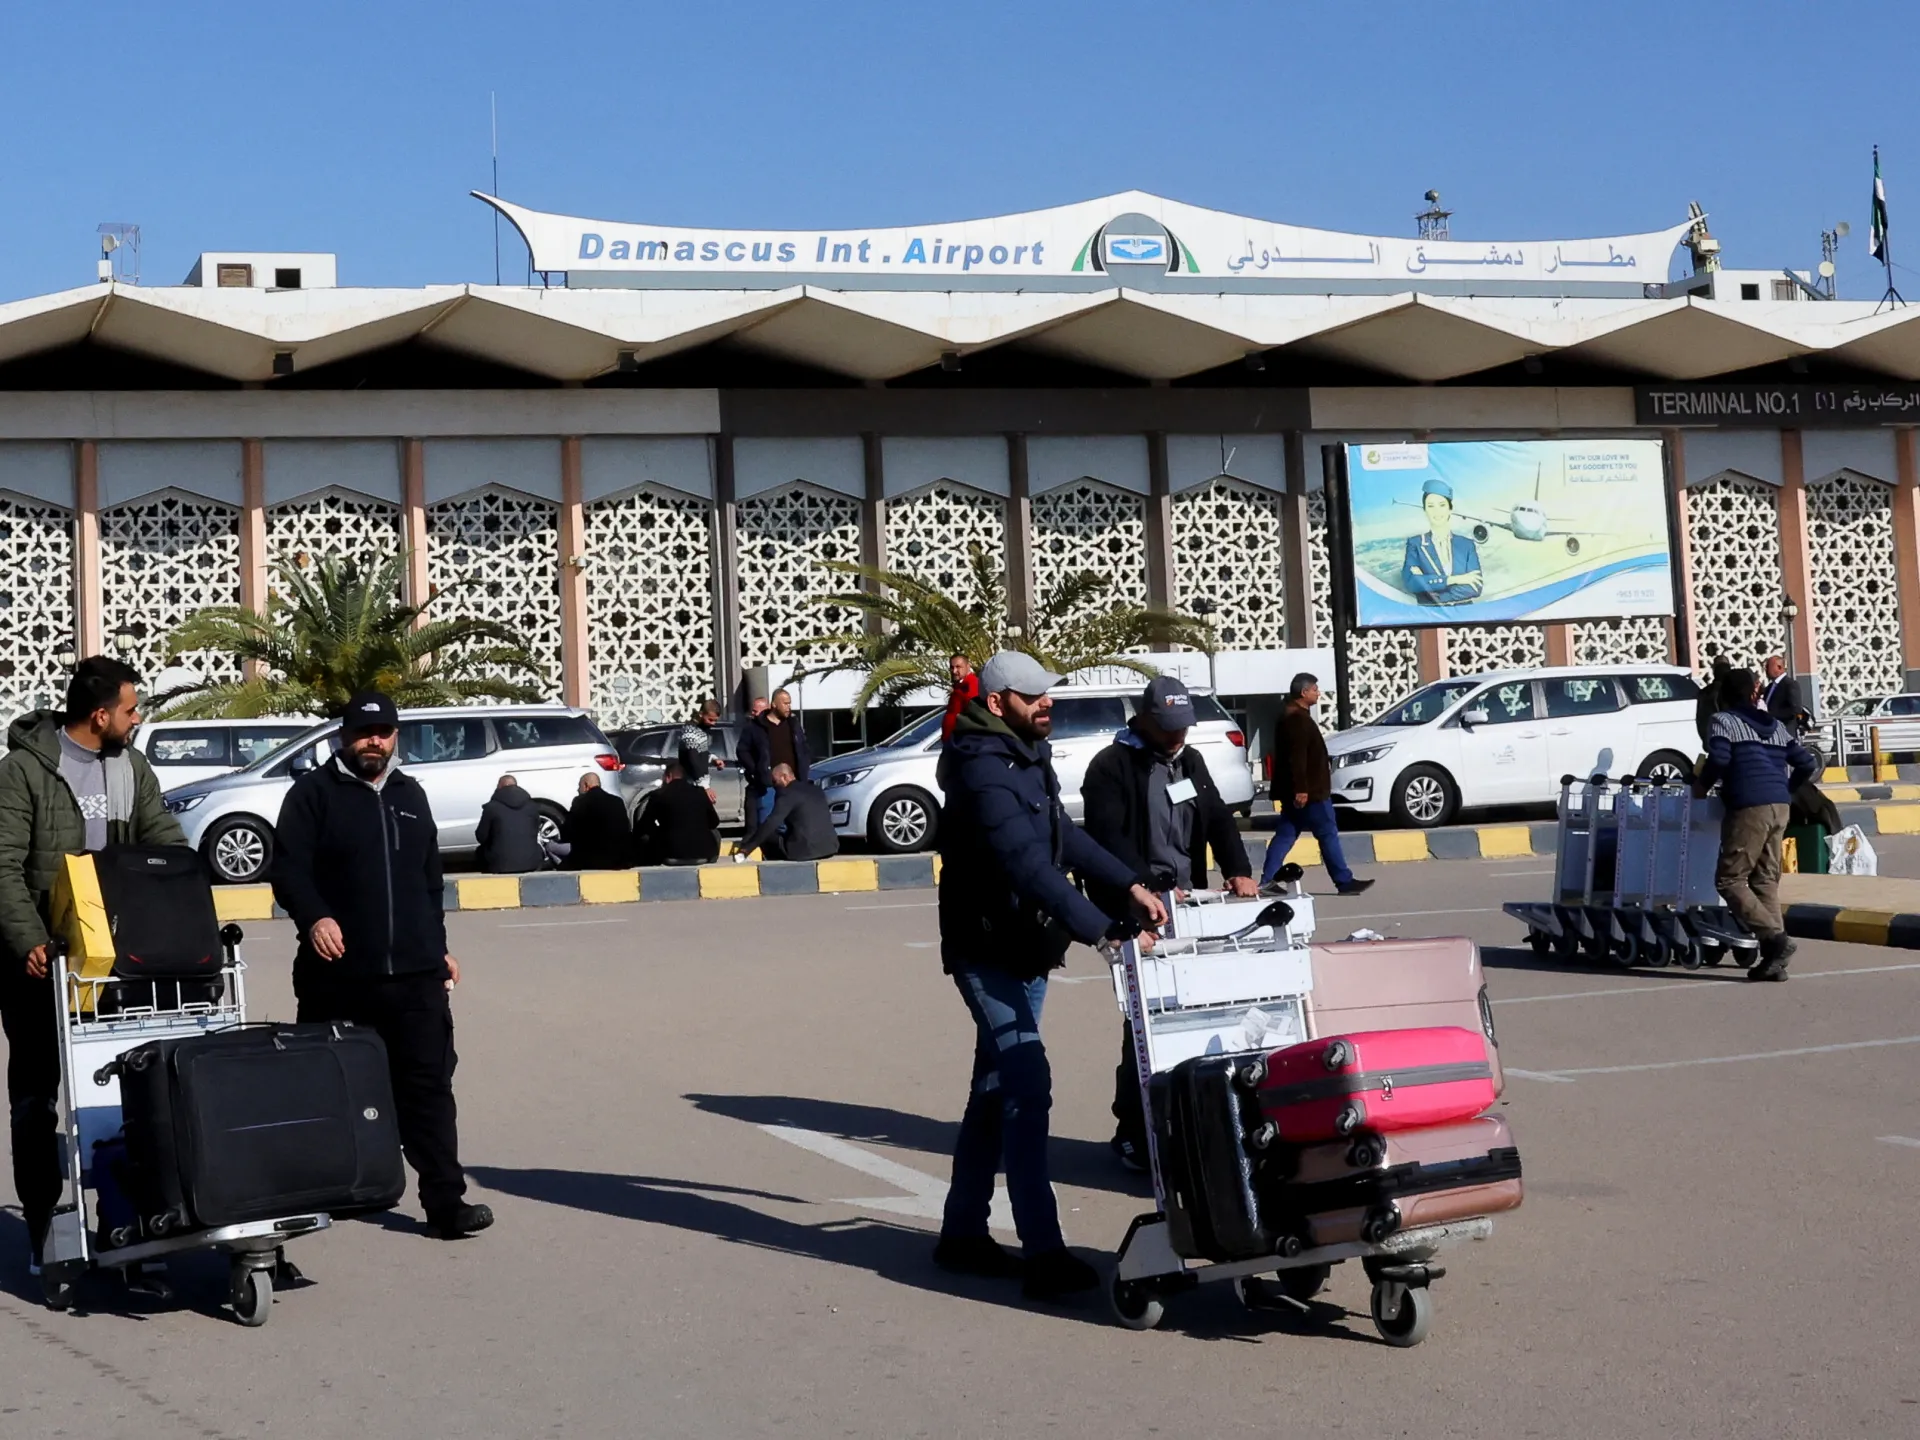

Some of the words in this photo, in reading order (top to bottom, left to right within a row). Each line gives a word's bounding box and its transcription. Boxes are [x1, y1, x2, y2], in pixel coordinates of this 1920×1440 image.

[579, 233, 796, 262] Damascus
[903, 238, 1045, 271] Airport
[1227, 239, 1382, 273] الدولي
[1406, 242, 1523, 274] دمشق
[1544, 243, 1637, 273] مطار
[1649, 392, 1752, 414] TERMINAL
[1756, 392, 1800, 414] NO.1
